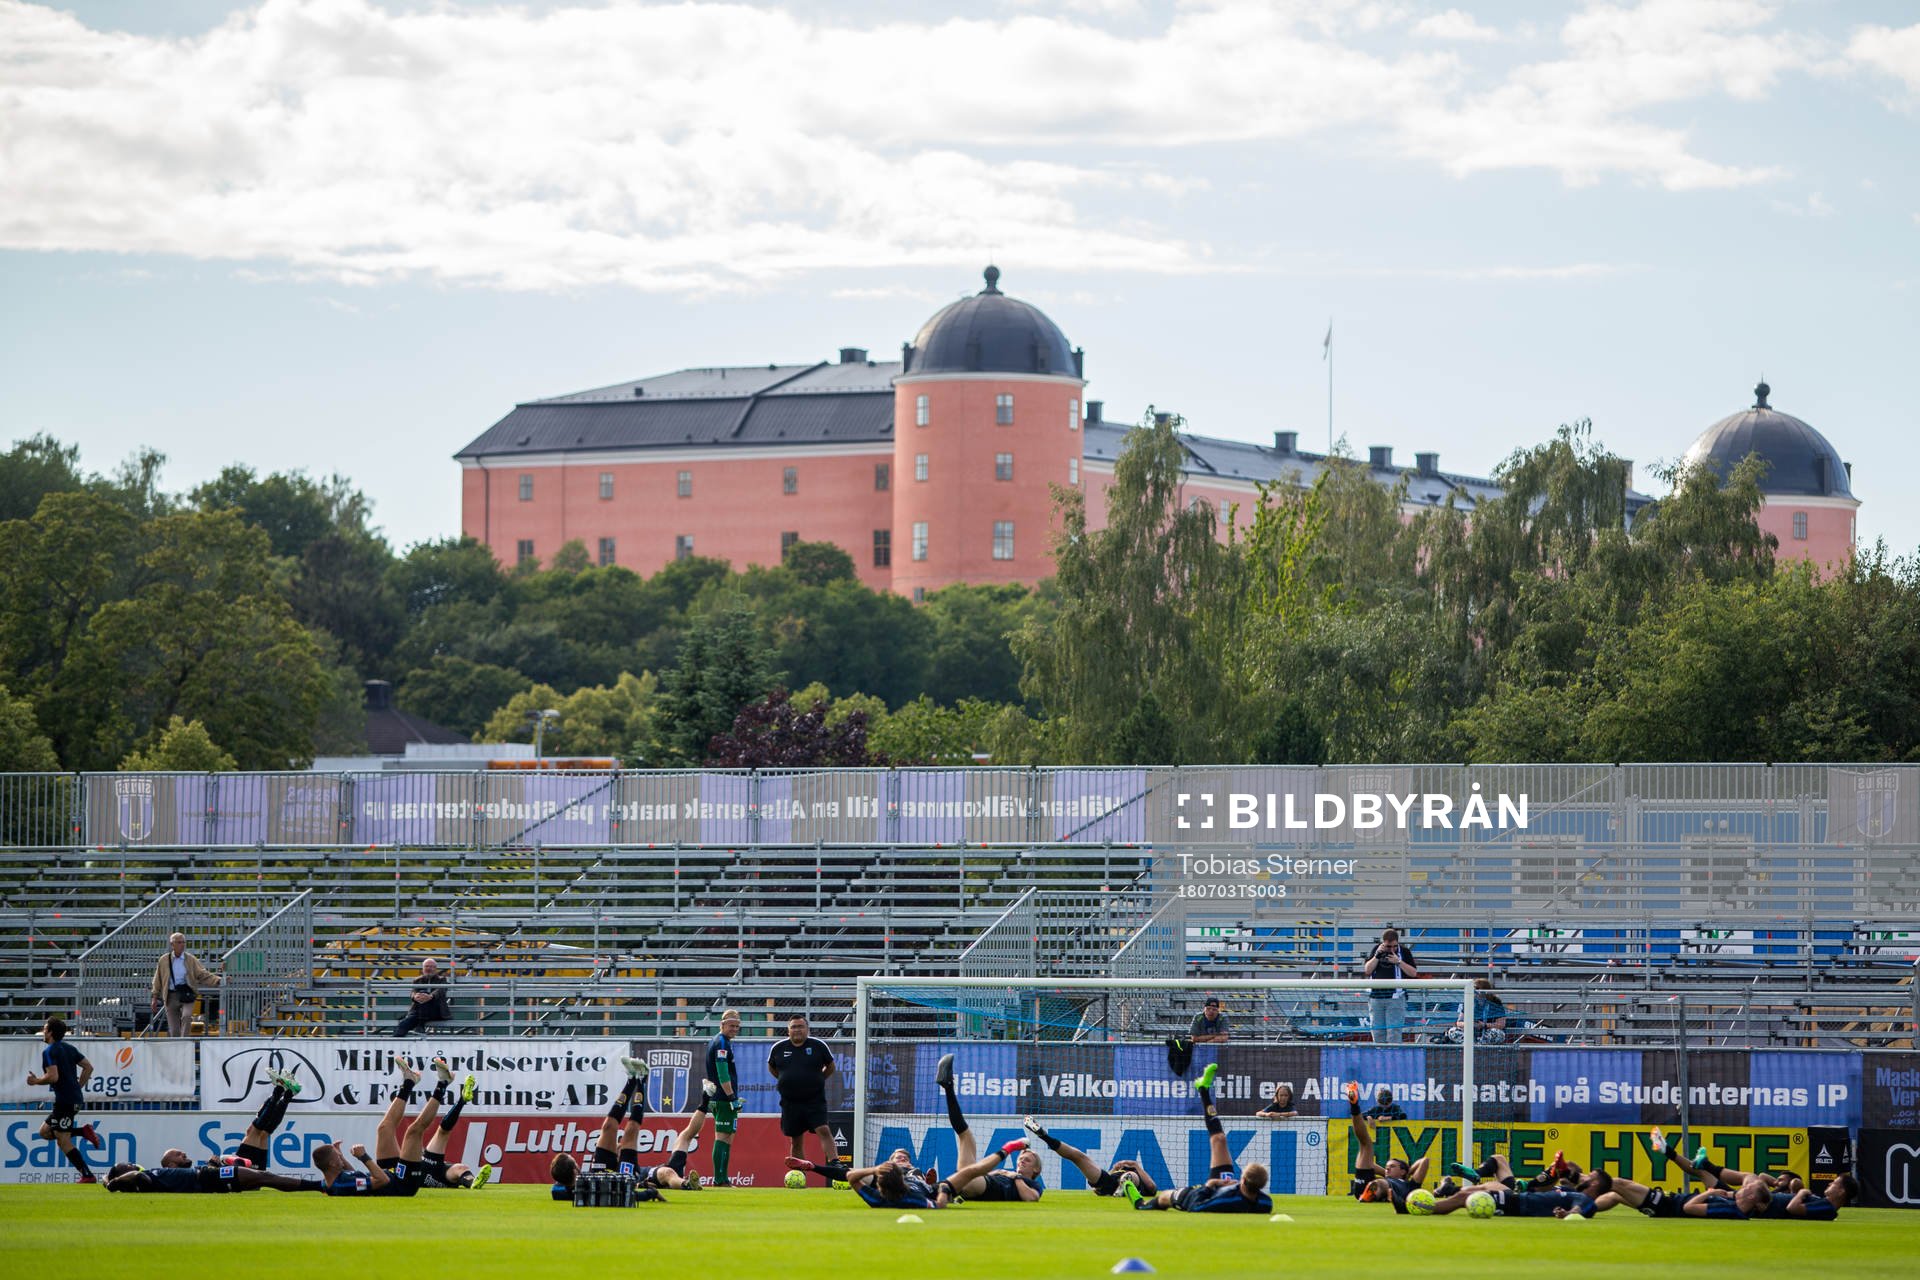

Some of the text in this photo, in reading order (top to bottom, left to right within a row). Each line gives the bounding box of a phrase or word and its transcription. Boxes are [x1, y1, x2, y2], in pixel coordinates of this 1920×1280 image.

[651, 1052, 688, 1066] SIRIUS
[333, 1083, 361, 1105] &
[560, 1083, 609, 1106] AB
[1215, 1074, 1250, 1099] till
[1555, 1077, 1589, 1108] på
[1599, 1080, 1808, 1107] Studenternas
[1818, 1084, 1848, 1107] IP
